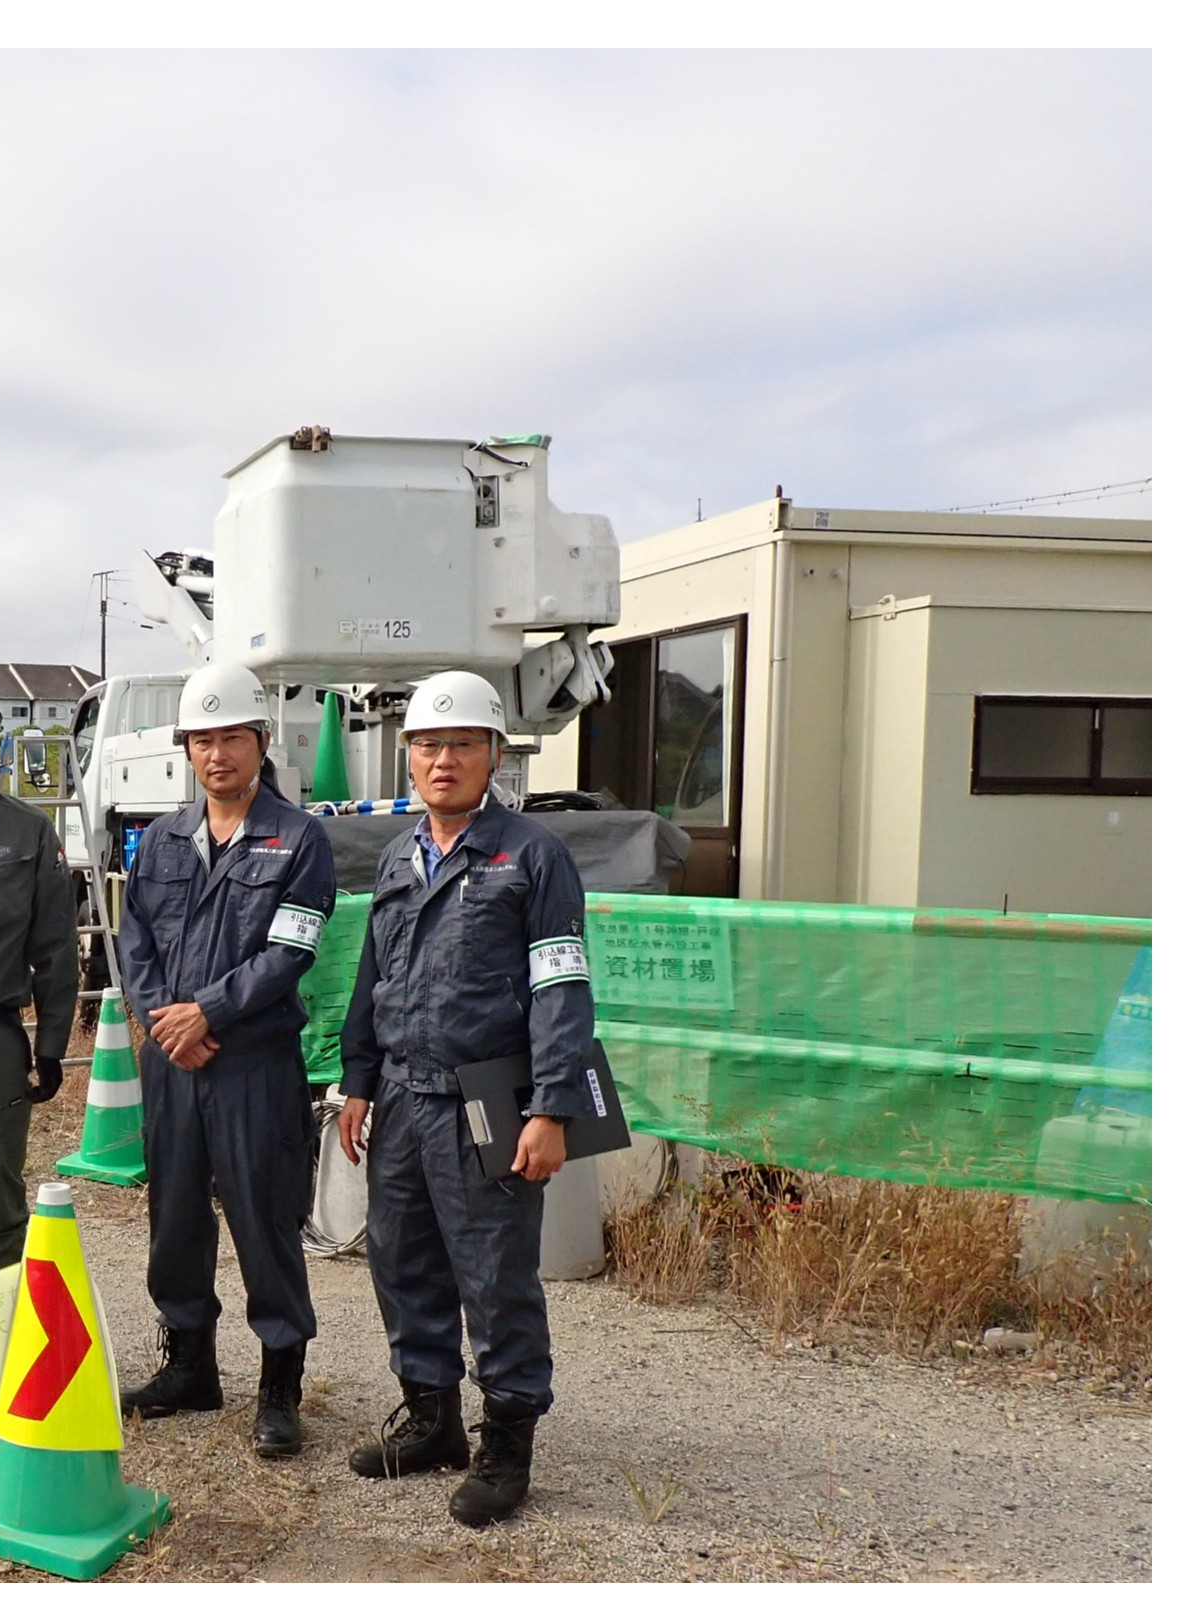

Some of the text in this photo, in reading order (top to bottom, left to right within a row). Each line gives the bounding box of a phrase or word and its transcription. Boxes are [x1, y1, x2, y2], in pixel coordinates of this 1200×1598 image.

[384, 620, 411, 638] 125
[604, 955, 716, 982] 資材置場
